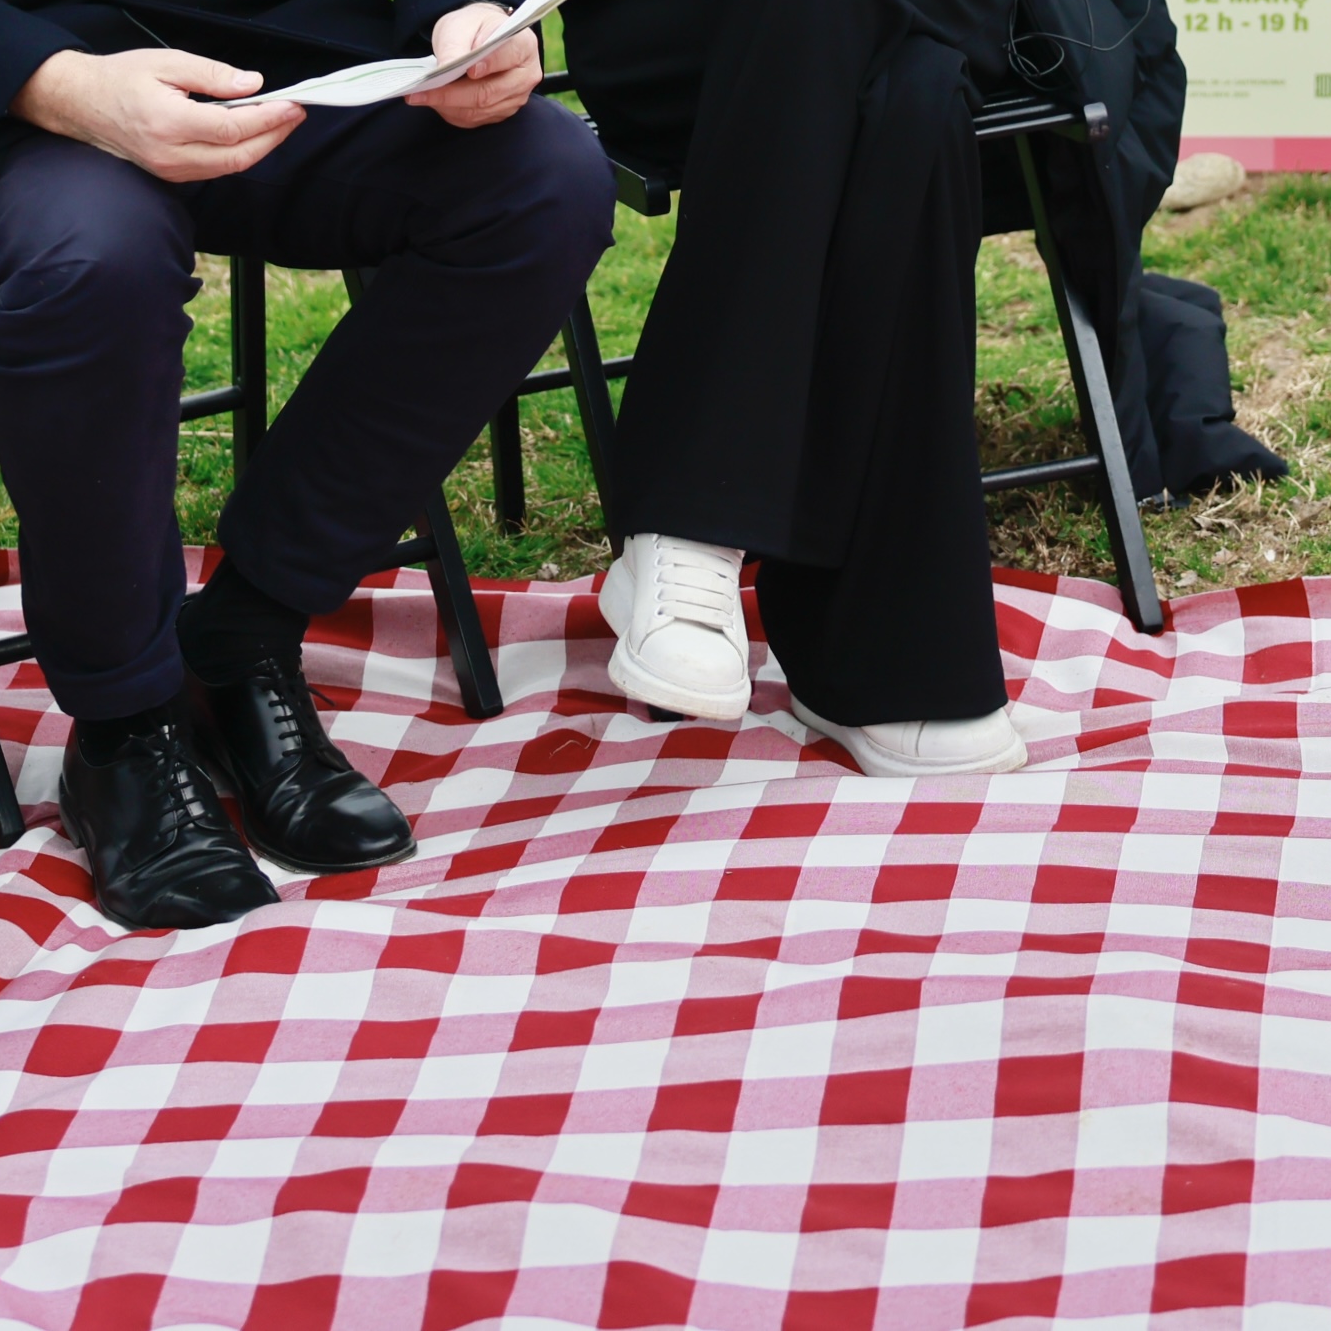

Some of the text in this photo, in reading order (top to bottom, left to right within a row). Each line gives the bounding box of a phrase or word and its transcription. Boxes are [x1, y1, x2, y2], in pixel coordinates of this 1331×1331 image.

[1183, 12, 1210, 33] 12
[1217, 11, 1233, 32] h
[1259, 12, 1286, 33] 19
[1293, 11, 1310, 32] h
